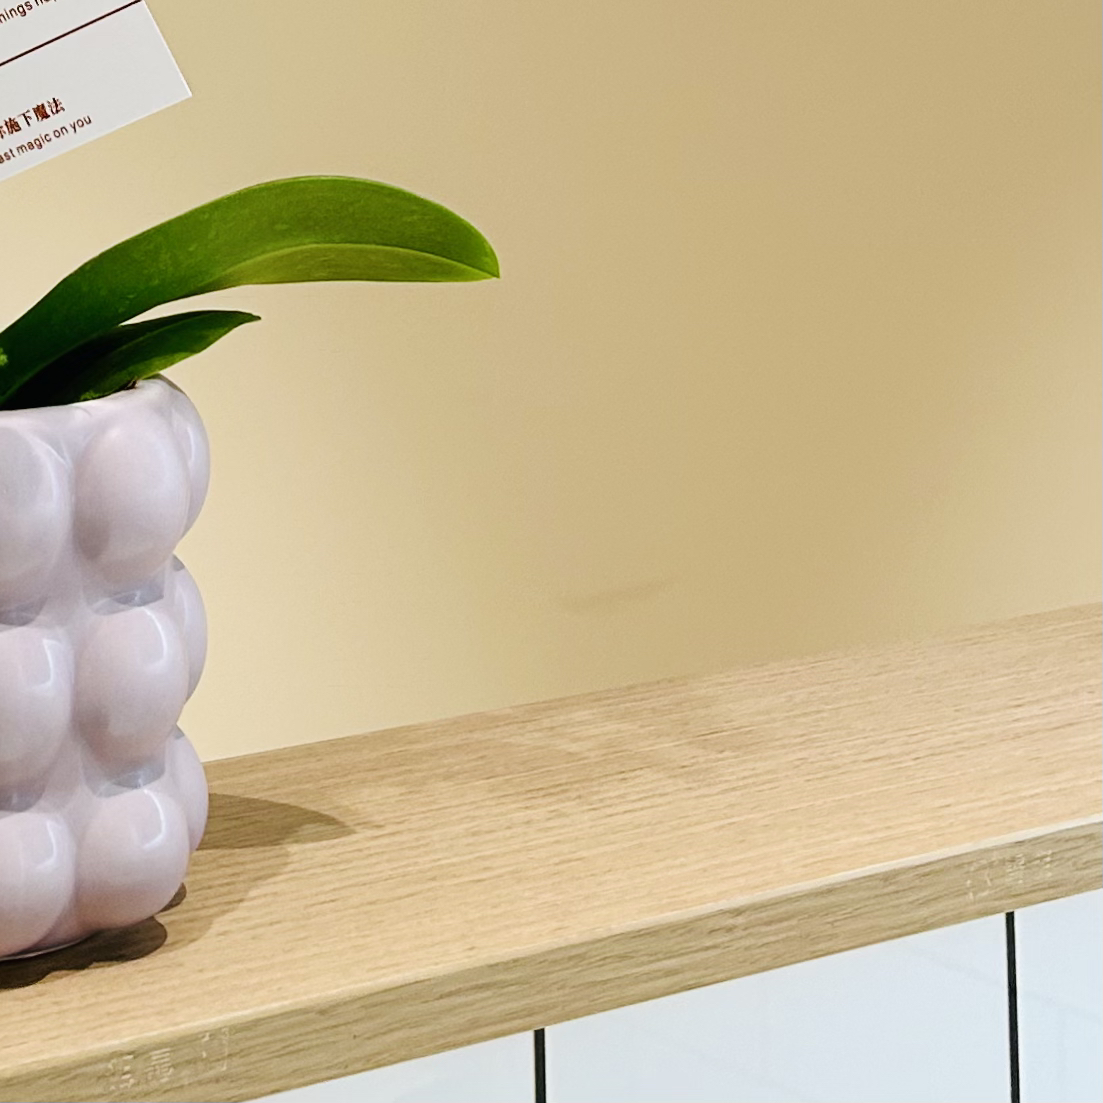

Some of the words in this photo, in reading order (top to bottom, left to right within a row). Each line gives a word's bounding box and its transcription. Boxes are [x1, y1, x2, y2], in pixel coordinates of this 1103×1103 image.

[16, 133, 52, 155] magic
[52, 125, 69, 139] on
[69, 115, 92, 134] you
